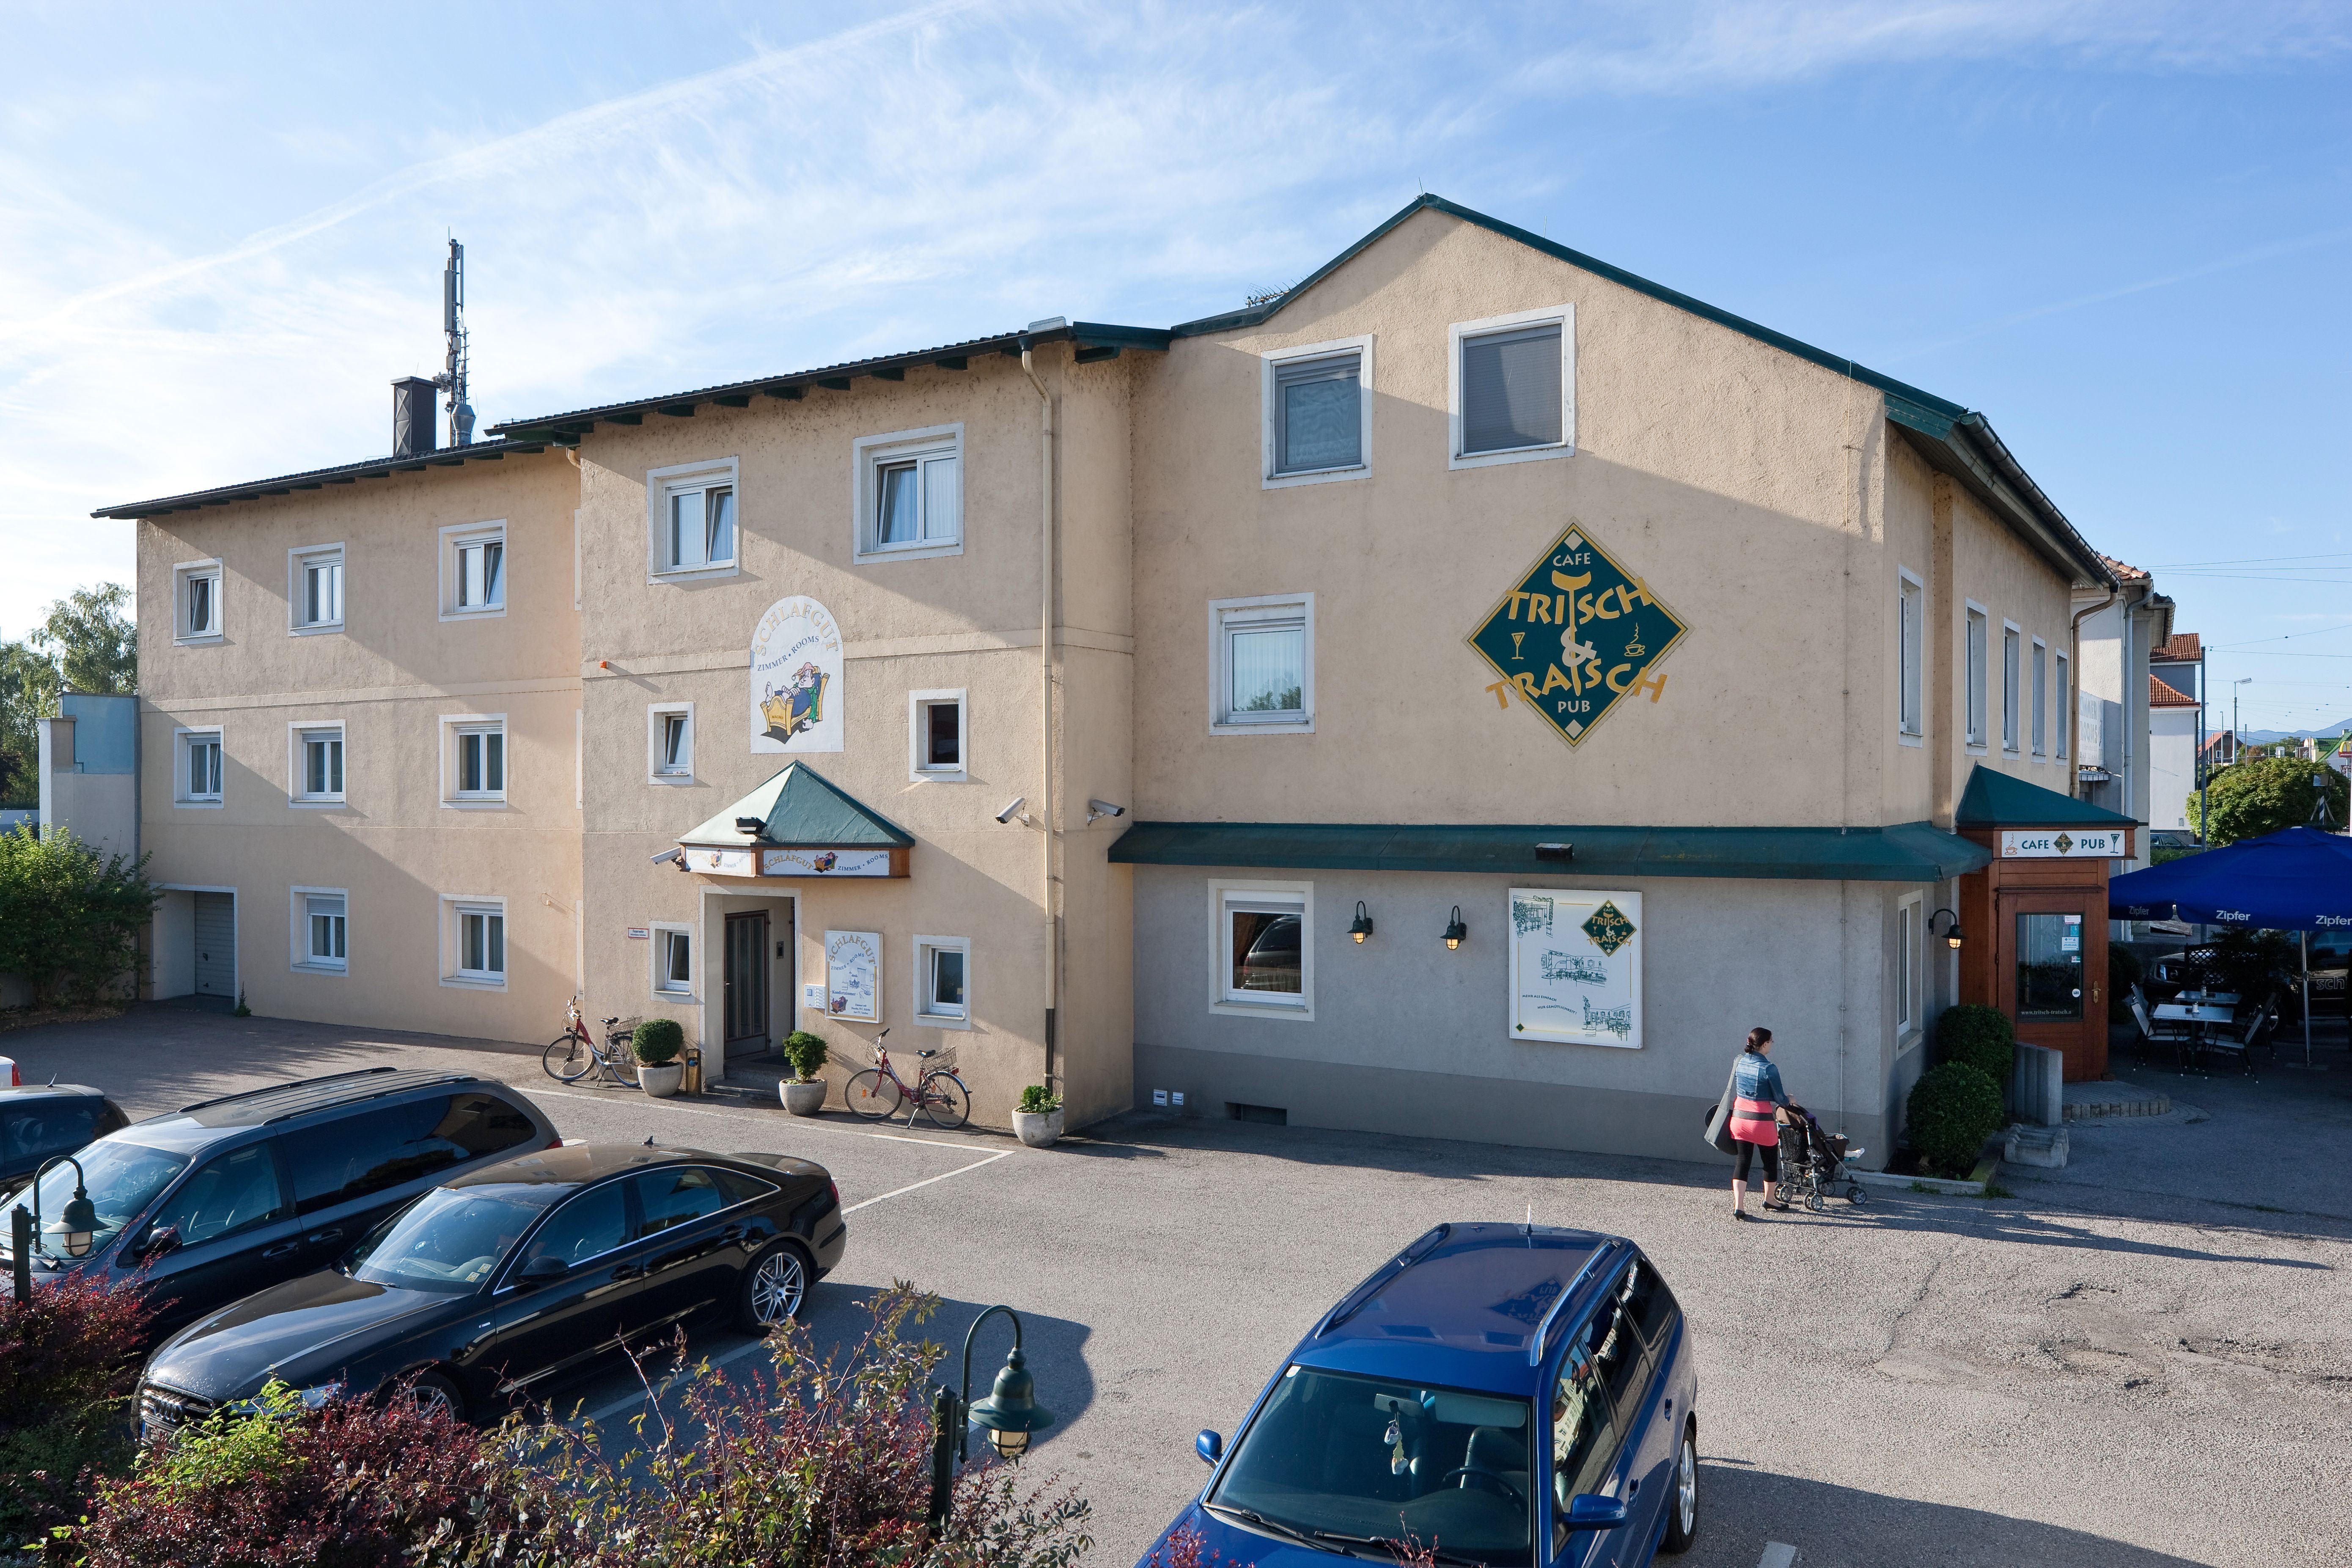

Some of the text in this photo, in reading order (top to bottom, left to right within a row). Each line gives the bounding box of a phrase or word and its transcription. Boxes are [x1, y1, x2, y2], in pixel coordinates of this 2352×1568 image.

[1552, 552, 1591, 567] CAFE
[755, 602, 839, 656] SCHLAFGUT
[1560, 626, 1598, 667] &
[757, 635, 820, 672] ZIMMER ROOMS
[1558, 700, 1591, 714] PUB
[2021, 839, 2049, 850] CAFE
[2081, 839, 2105, 849] PUB
[764, 854, 814, 871] SCHLAFGUT
[867, 853, 889, 865] ROOMS
[2129, 905, 2149, 916] Zipfer
[2216, 910, 2251, 922] Zipfer
[2315, 915, 2352, 927] Zipfer
[829, 934, 876, 965] SCHLAFGUT
[849, 953, 865, 964] ROOMS
